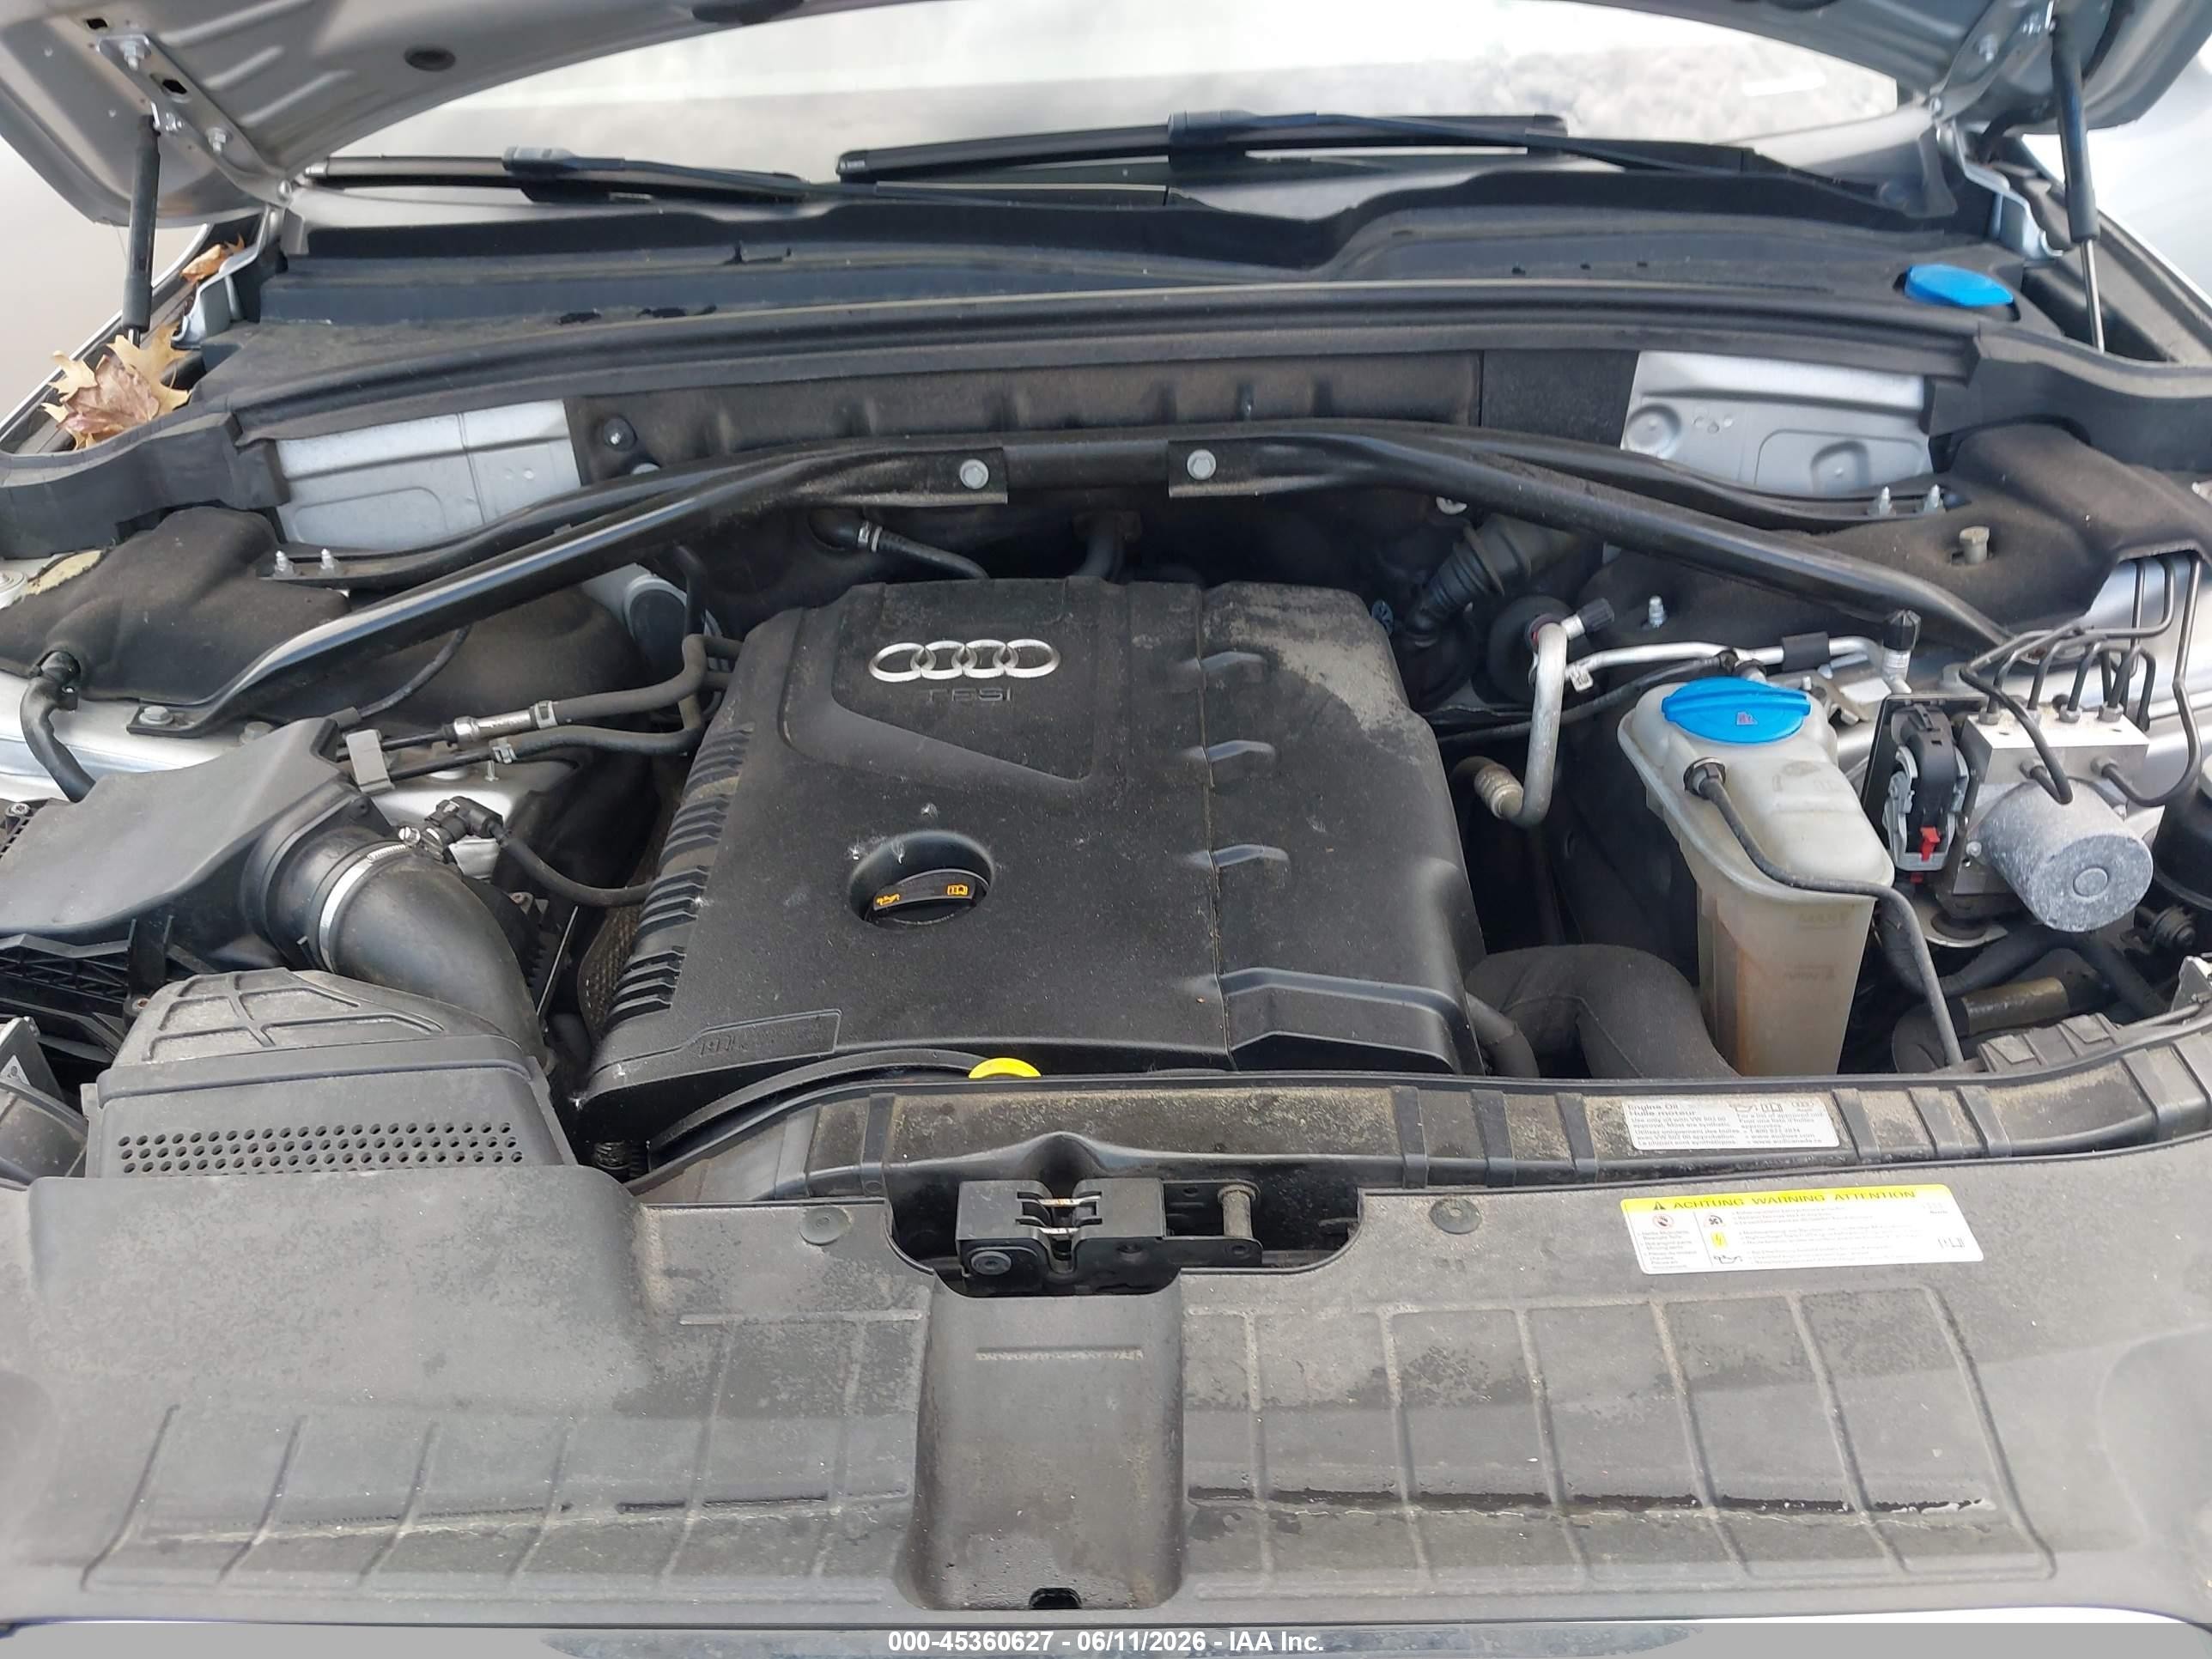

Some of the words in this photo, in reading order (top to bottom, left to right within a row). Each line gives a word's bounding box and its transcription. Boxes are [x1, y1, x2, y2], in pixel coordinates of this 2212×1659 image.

[1674, 1199, 1744, 1210] ACHTUNG
[1751, 1194, 1826, 1206] WARNING
[1834, 1191, 1916, 1201] ATTENTION
